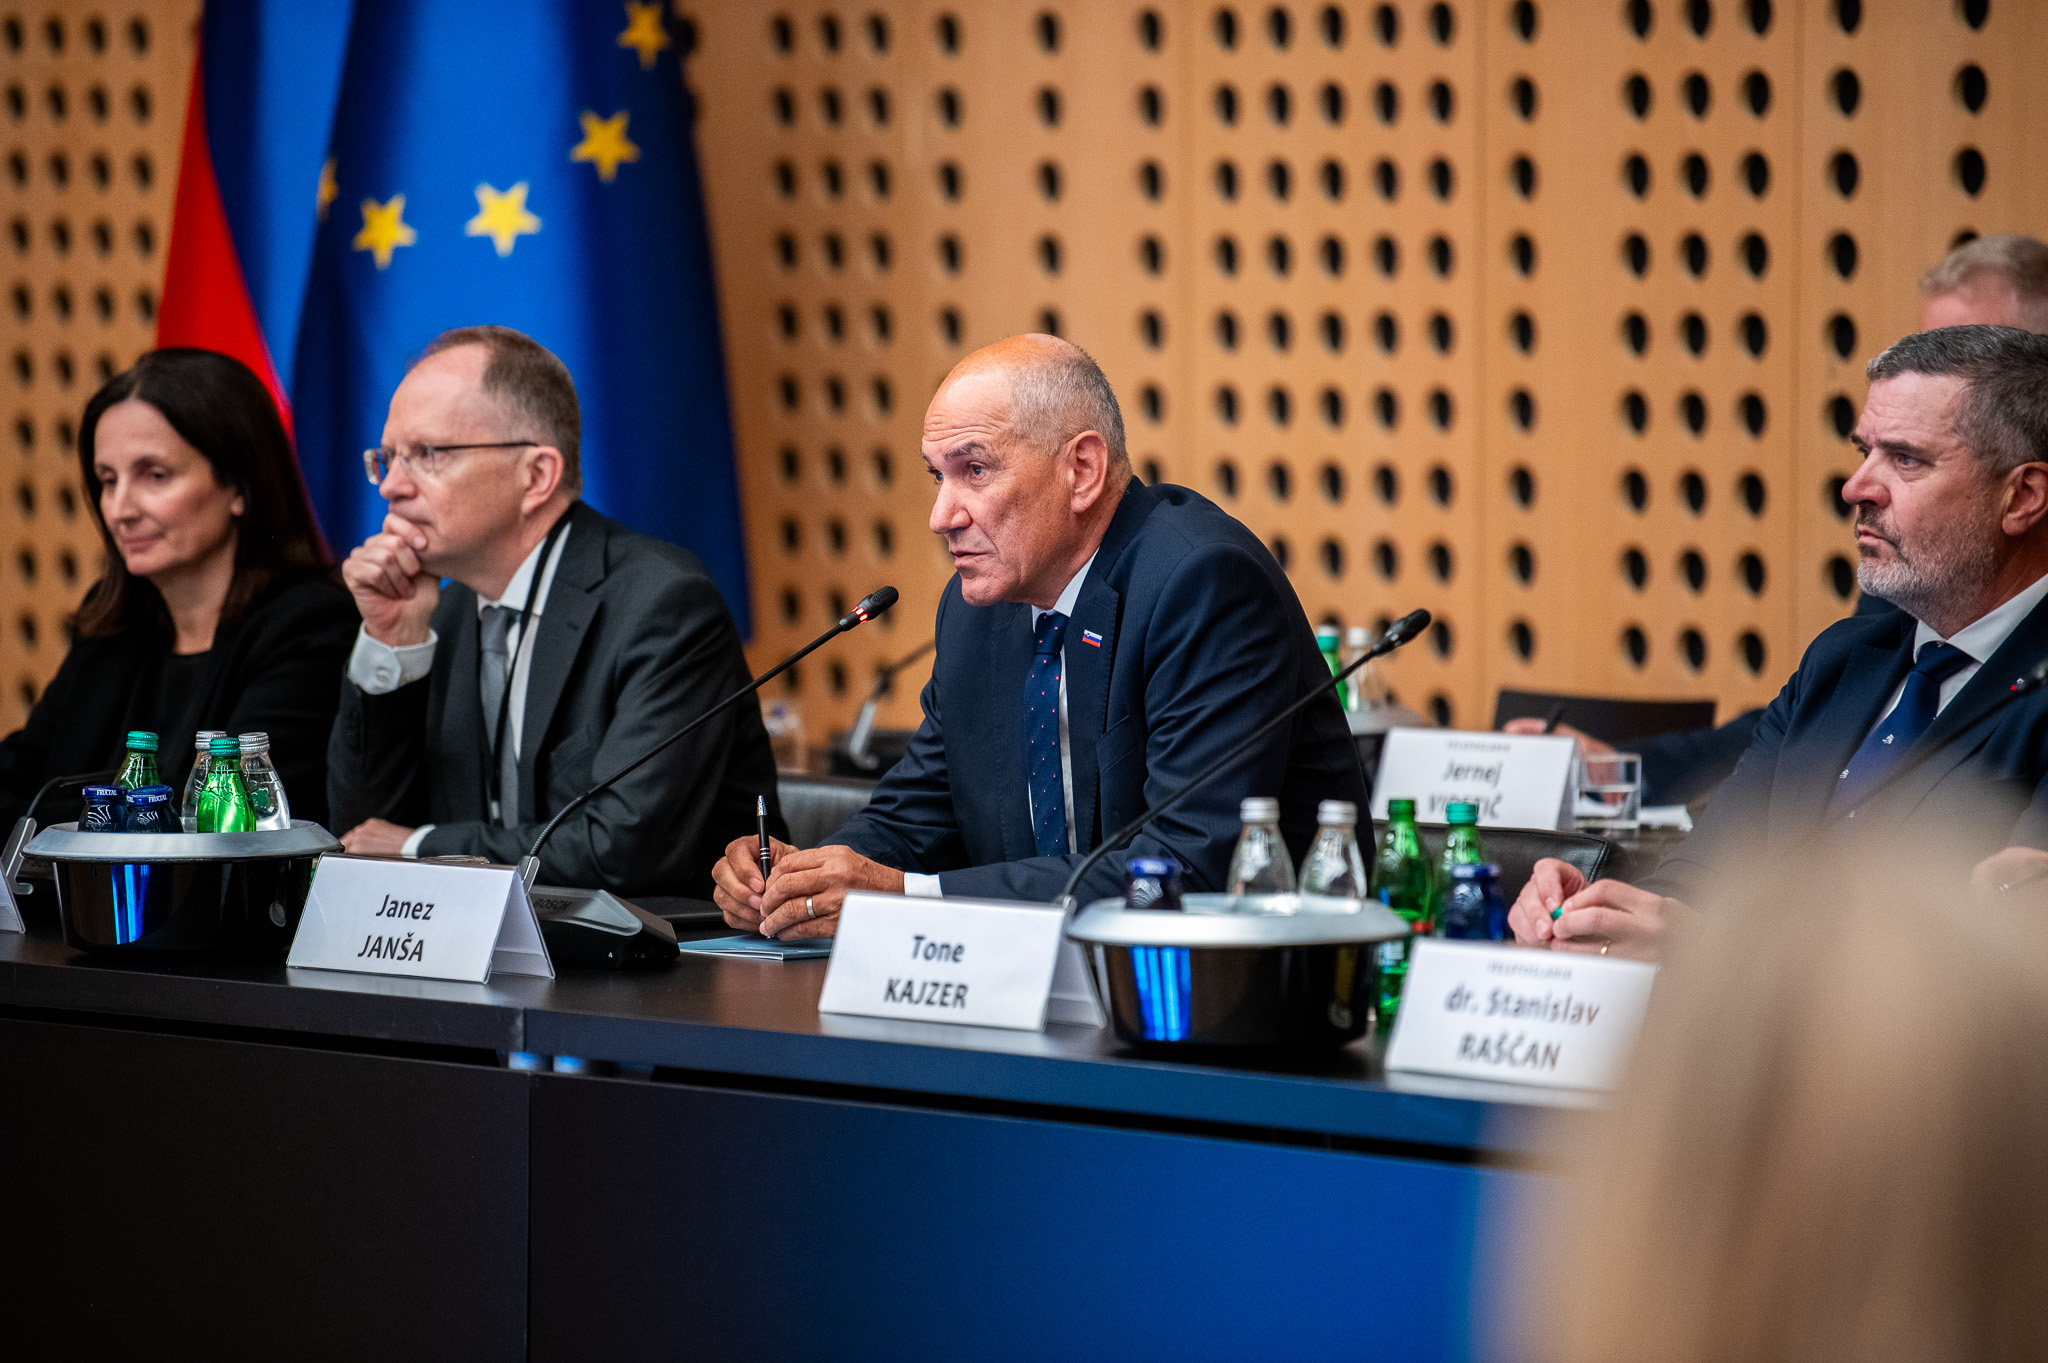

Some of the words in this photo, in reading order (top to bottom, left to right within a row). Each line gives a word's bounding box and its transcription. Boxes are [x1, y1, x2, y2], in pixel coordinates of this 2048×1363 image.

[1443, 760, 1504, 788] Jernej
[375, 893, 435, 921] Janez
[534, 898, 570, 910] BOSCH
[357, 931, 425, 962] JANŠA
[912, 934, 965, 963] Tone
[884, 977, 969, 1008] KAJZER
[1444, 981, 1479, 1014] dr.
[1485, 986, 1600, 1026] Stanislav
[1457, 1029, 1562, 1072] RAŠČAN
